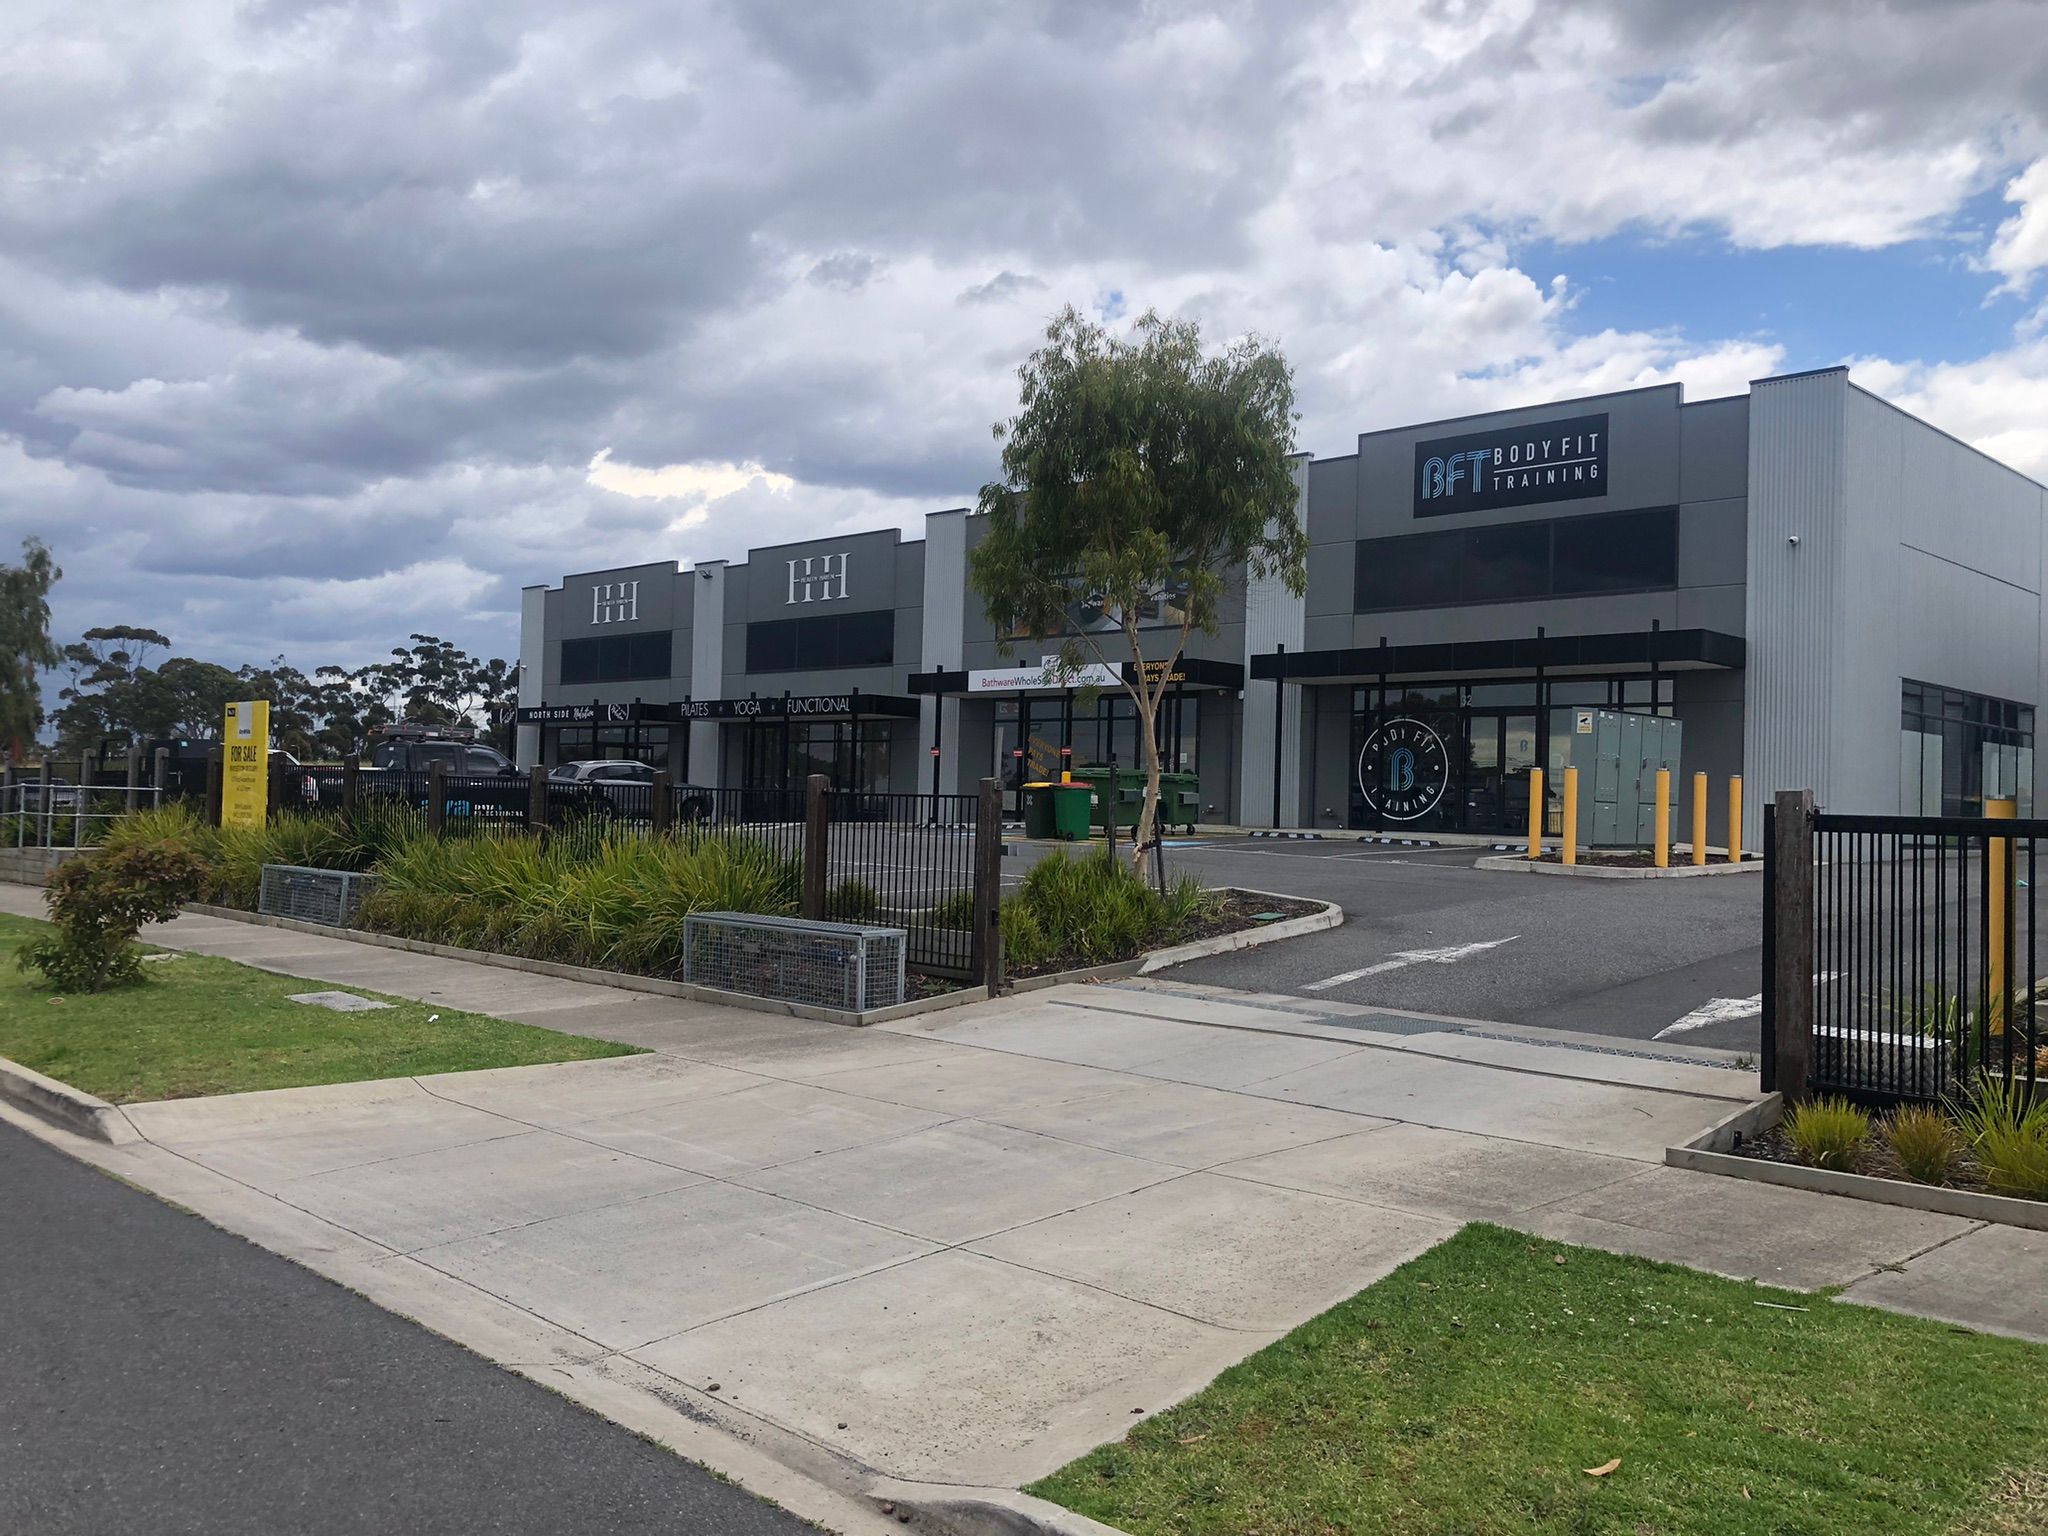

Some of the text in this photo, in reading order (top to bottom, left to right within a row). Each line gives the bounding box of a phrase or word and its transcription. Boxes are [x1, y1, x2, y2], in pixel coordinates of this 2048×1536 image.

[1493, 433, 1599, 466] BODY FIT
[1422, 449, 1492, 500] BFT
[1493, 464, 1599, 491] TRAINING
[681, 703, 710, 717] PILATES
[733, 701, 761, 715] YOGA
[787, 698, 850, 714] FUNCTIONAL
[529, 710, 551, 719] NORTH
[553, 710, 569, 718] SIDE
[231, 745, 257, 762] FOR SALE
